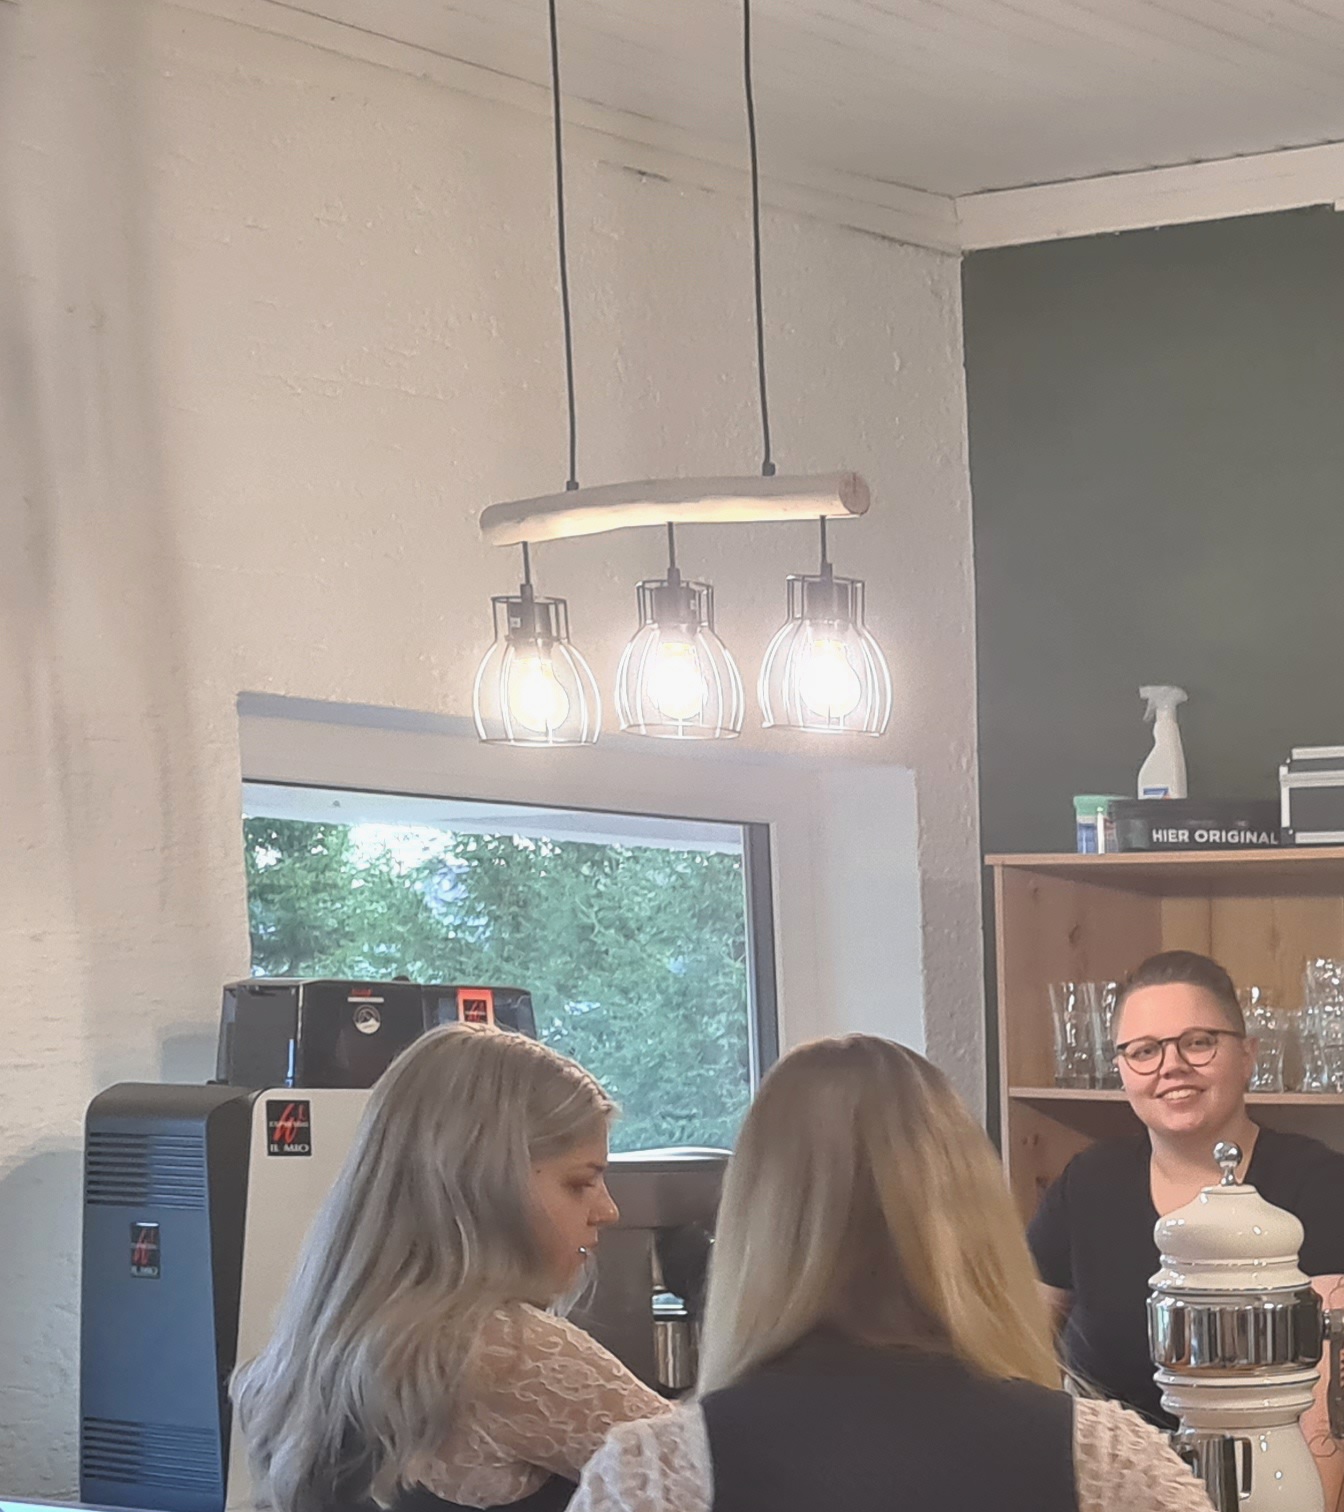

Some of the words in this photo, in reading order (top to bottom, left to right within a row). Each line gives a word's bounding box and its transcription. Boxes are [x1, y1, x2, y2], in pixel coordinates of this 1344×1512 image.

[1152, 828, 1189, 843] HIER
[1194, 829, 1279, 845] ORIGINAL
[283, 1143, 310, 1153] MIO
